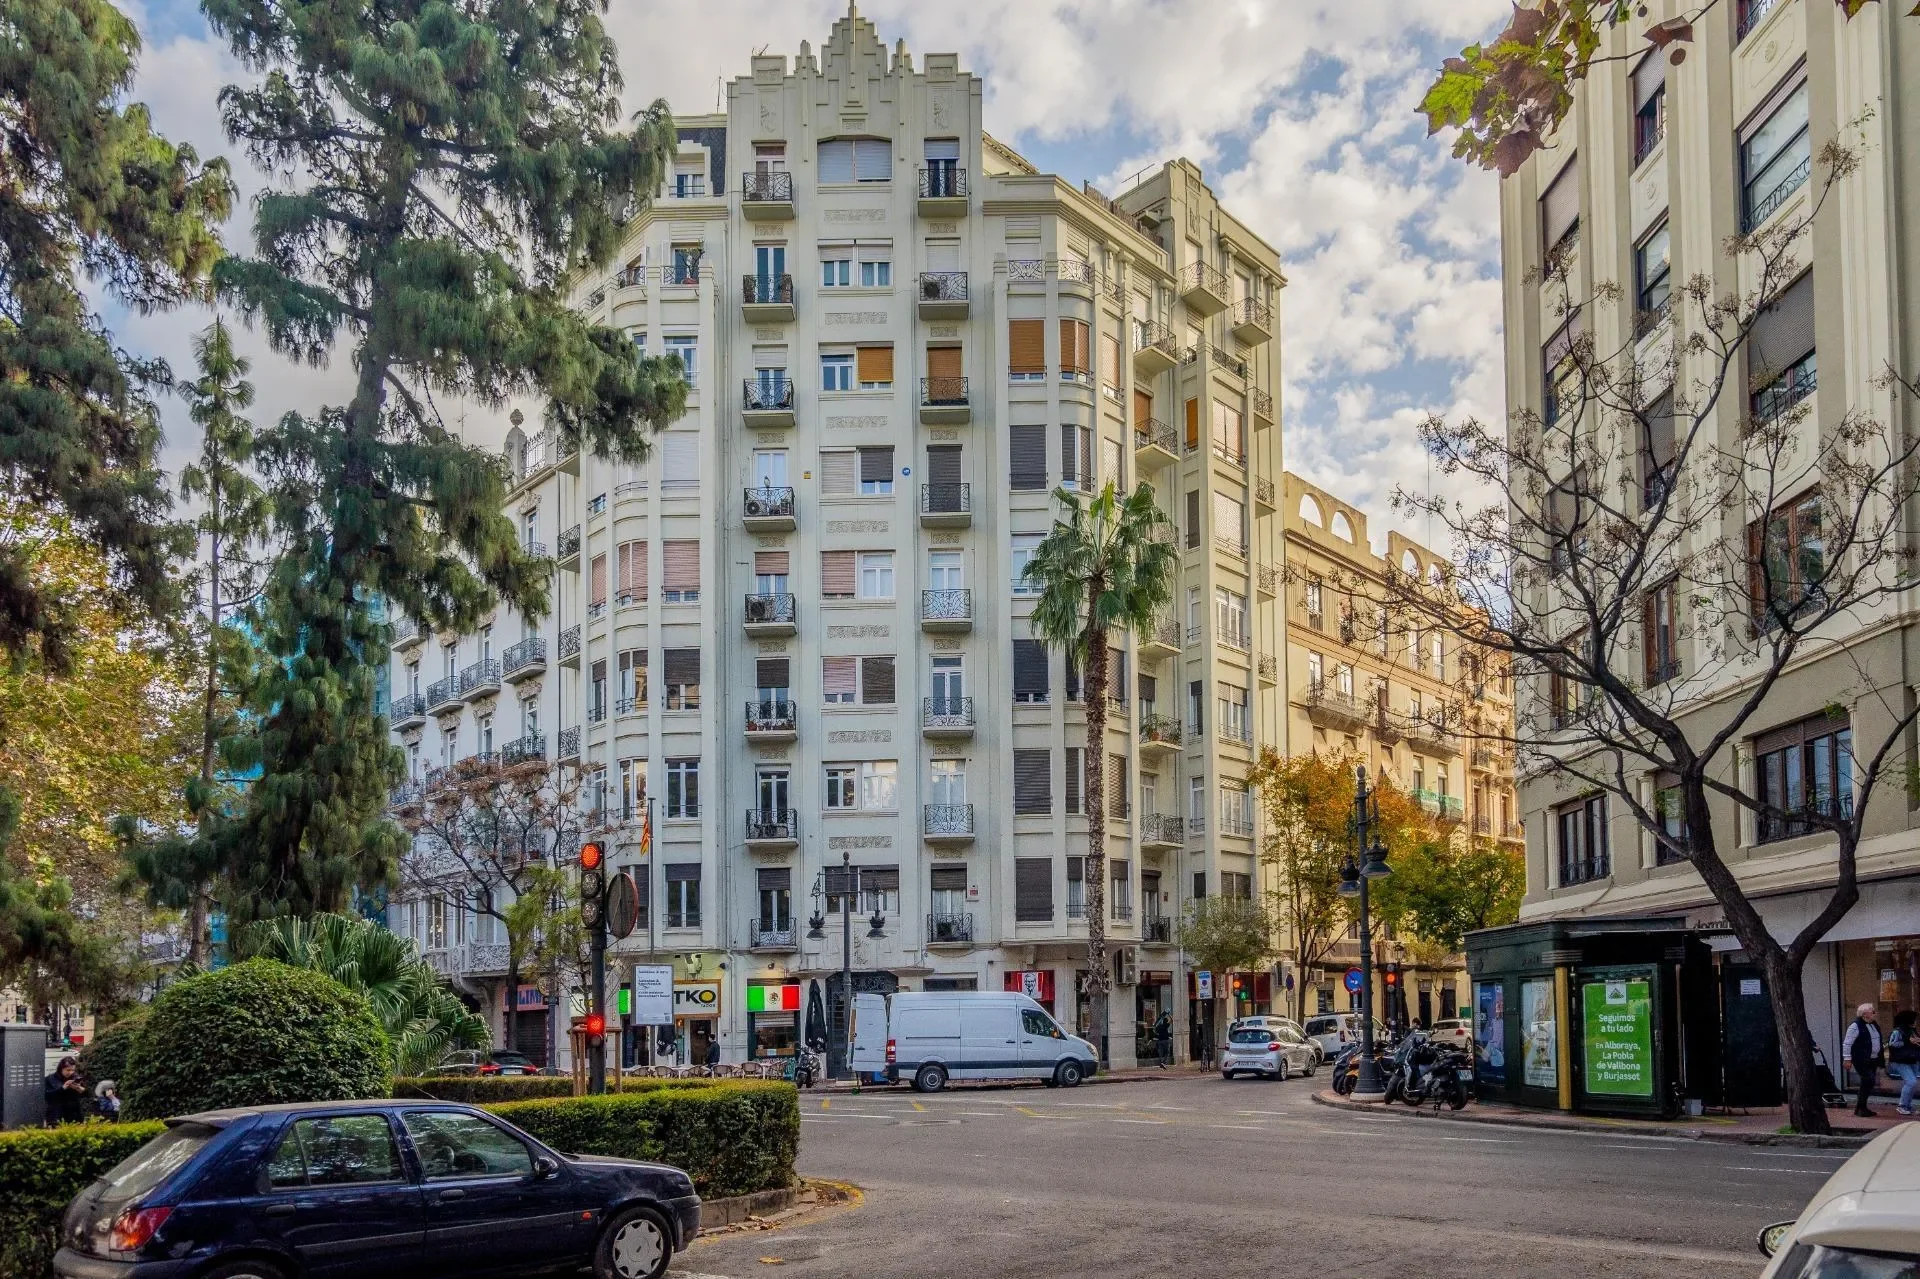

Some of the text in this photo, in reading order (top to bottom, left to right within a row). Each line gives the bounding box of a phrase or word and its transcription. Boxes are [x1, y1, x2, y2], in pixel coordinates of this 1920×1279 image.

[674, 990, 716, 1004] TKO
[1598, 1014, 1636, 1024] Seguimos
[1607, 1024, 1616, 1032] tu
[1616, 1024, 1634, 1032] lado
[1604, 1041, 1641, 1051] Alboraya,
[1602, 1051, 1634, 1059] La Pobla
[1596, 1061, 1641, 1070] de Vallbona
[1603, 1071, 1641, 1081] Burjassot
